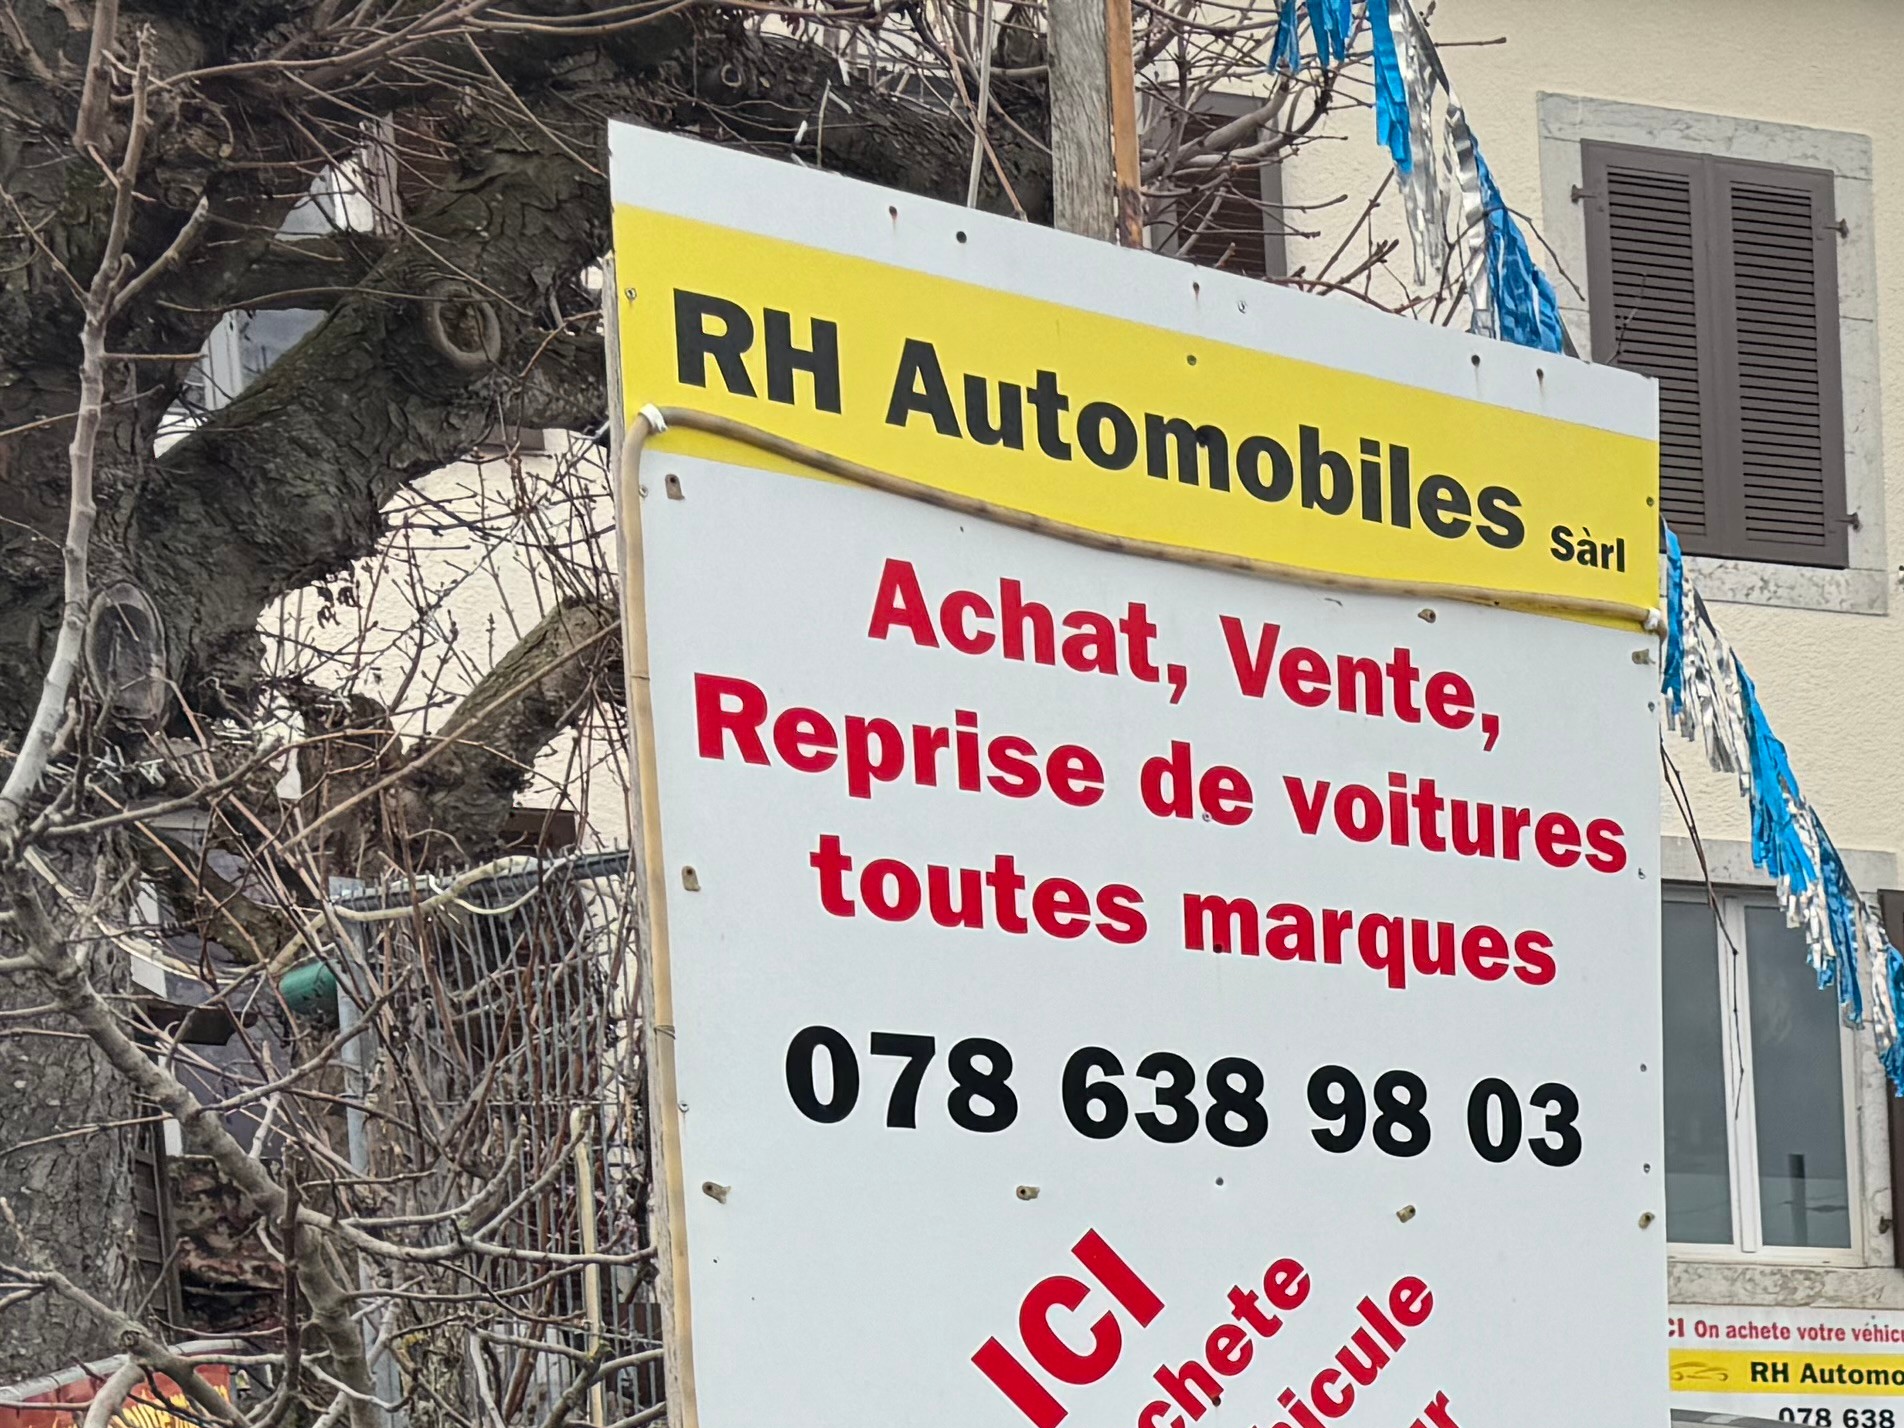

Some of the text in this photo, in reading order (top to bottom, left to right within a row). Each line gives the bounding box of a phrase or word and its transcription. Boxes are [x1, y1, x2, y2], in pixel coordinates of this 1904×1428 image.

[674, 289, 1626, 573] RH Automobiles Sàrl
[869, 560, 1499, 750] Achat, Vente,
[695, 674, 1627, 873] Reprise de voitures
[811, 835, 1556, 989] toutes marques
[786, 1026, 1581, 1166] 078 638 98 03
[1694, 1320, 1719, 1338] On
[1725, 1321, 1791, 1340] achete
[1797, 1324, 1846, 1341] votre
[1750, 1362, 1789, 1383] RH
[1779, 1407, 1832, 1428] 078
